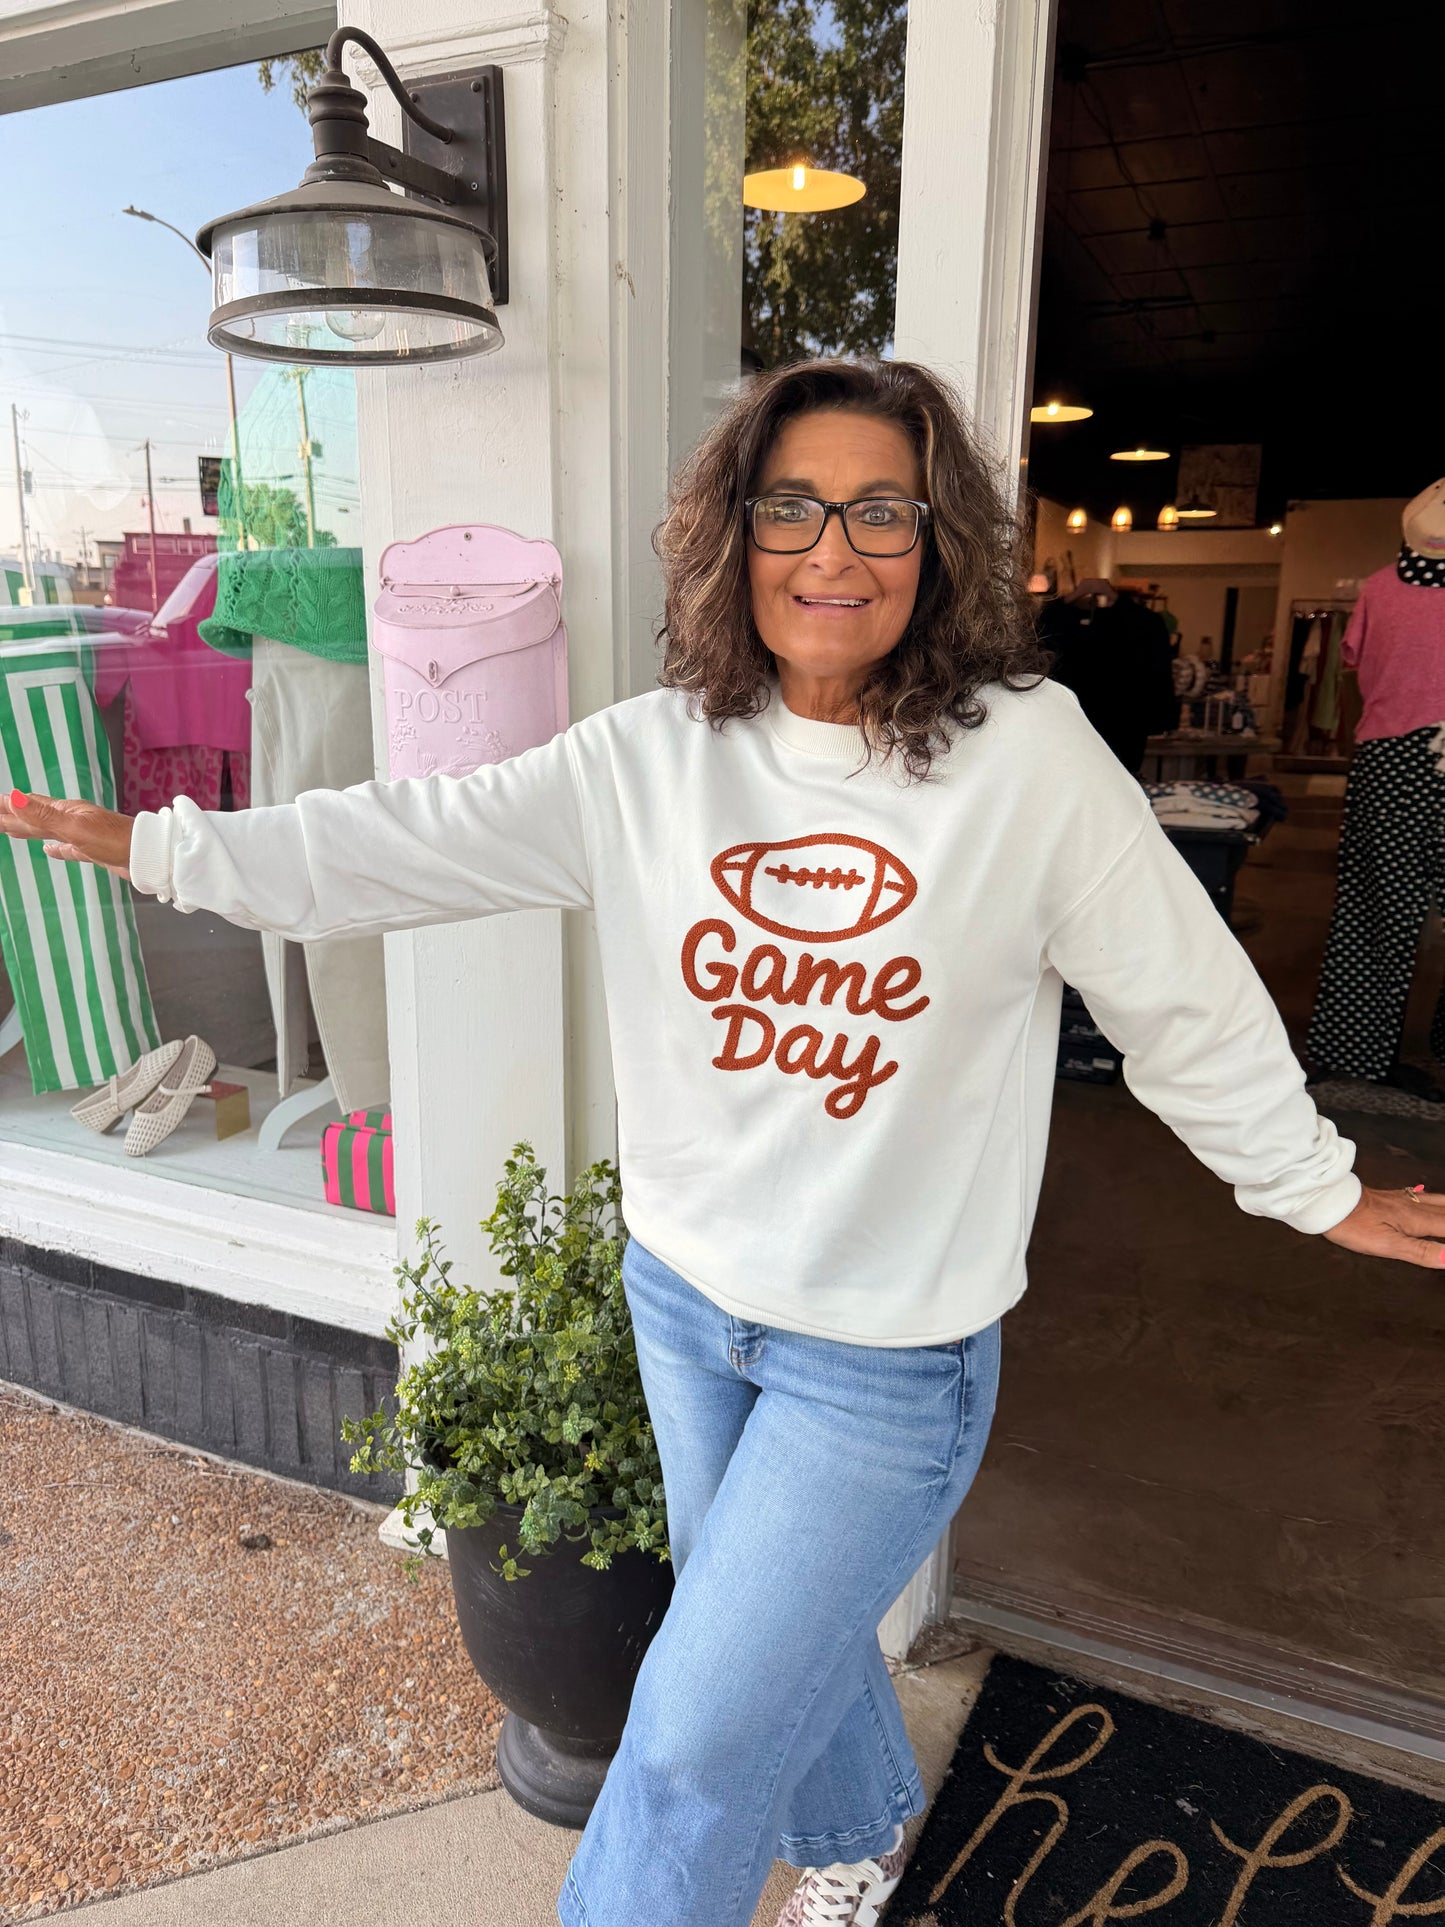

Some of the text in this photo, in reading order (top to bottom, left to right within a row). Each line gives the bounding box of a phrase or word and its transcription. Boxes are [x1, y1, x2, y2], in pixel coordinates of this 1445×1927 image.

[394, 689, 488, 724] POST
[681, 918, 930, 1021] Game
[712, 1004, 899, 1120] Day
